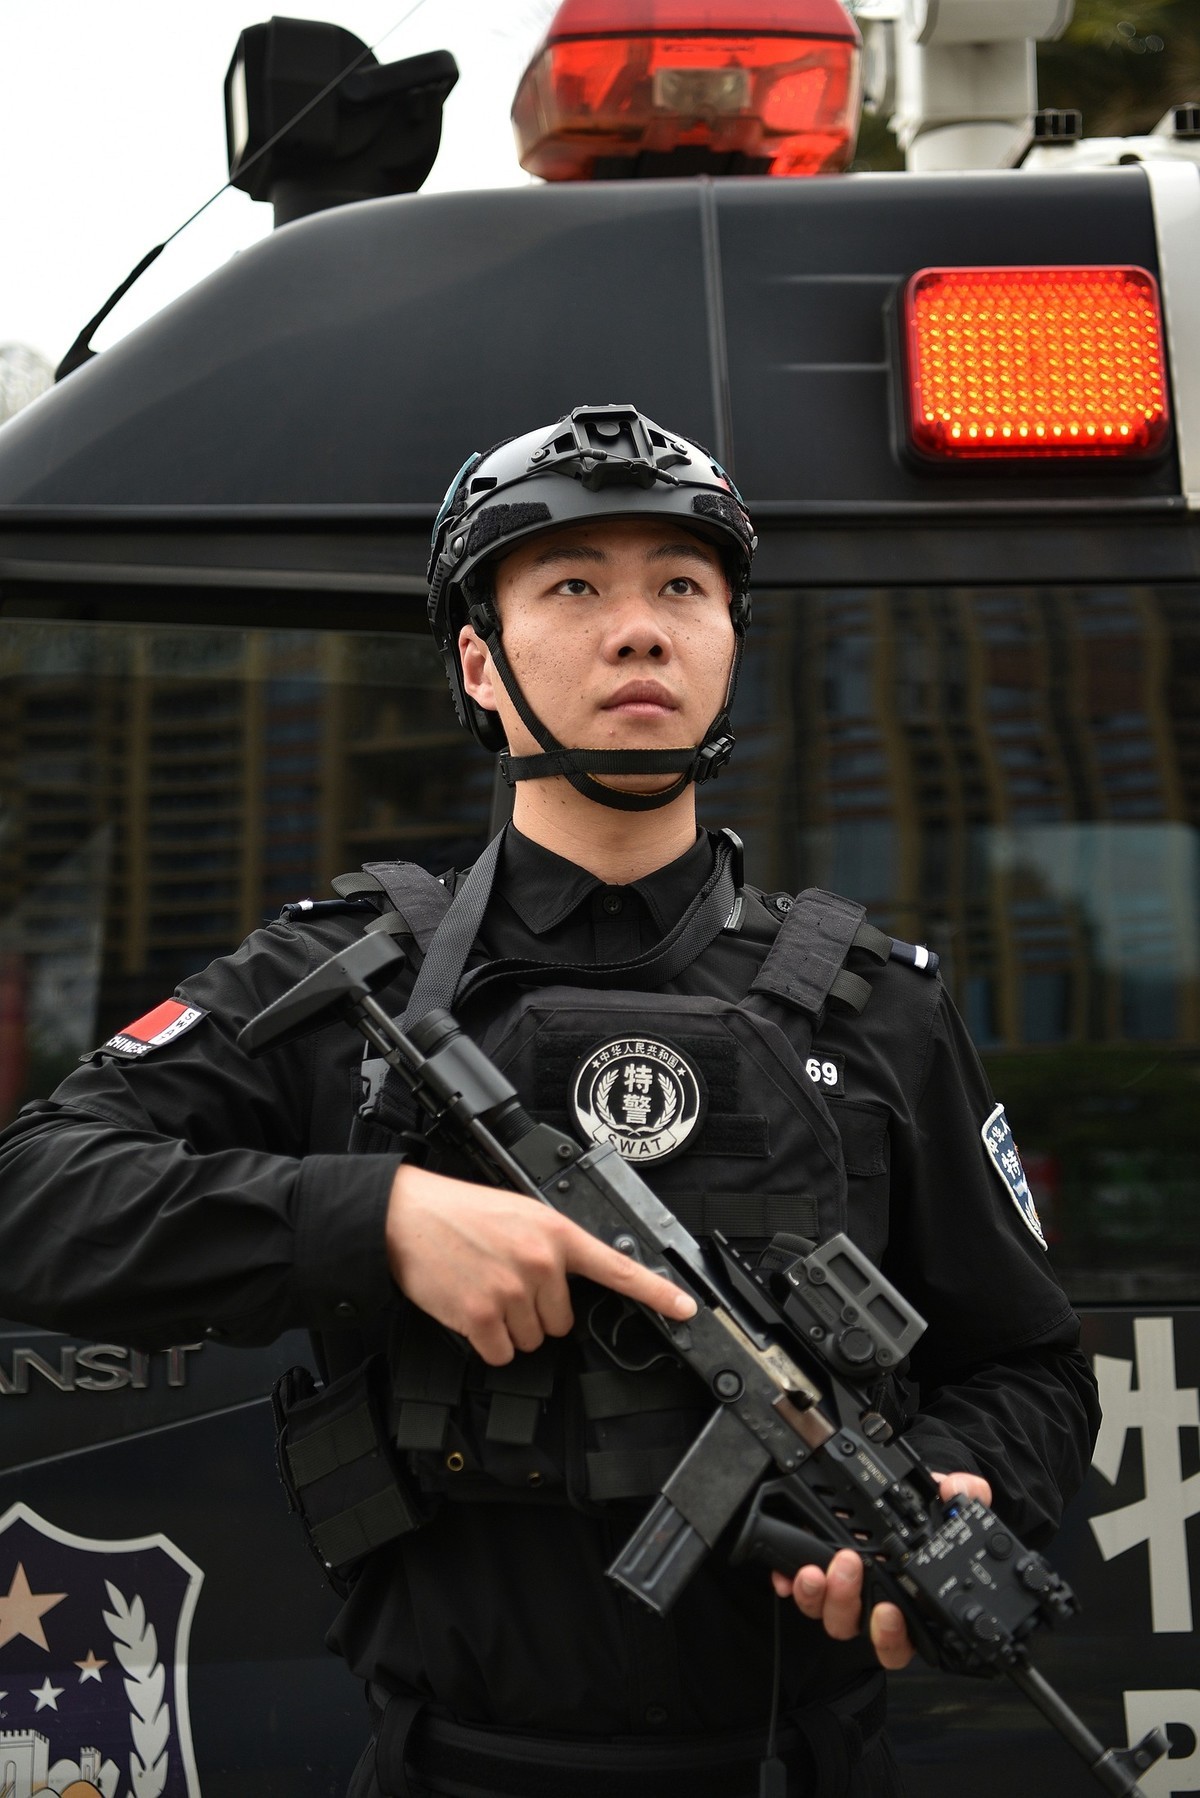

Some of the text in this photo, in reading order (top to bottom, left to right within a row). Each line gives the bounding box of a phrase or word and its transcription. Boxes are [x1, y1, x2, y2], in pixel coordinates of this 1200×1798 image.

[600, 1042, 679, 1069] 中华人民共和国
[805, 1058, 838, 1086] 69
[622, 1063, 654, 1125] 特警
[0, 1342, 204, 1395] NSIT
